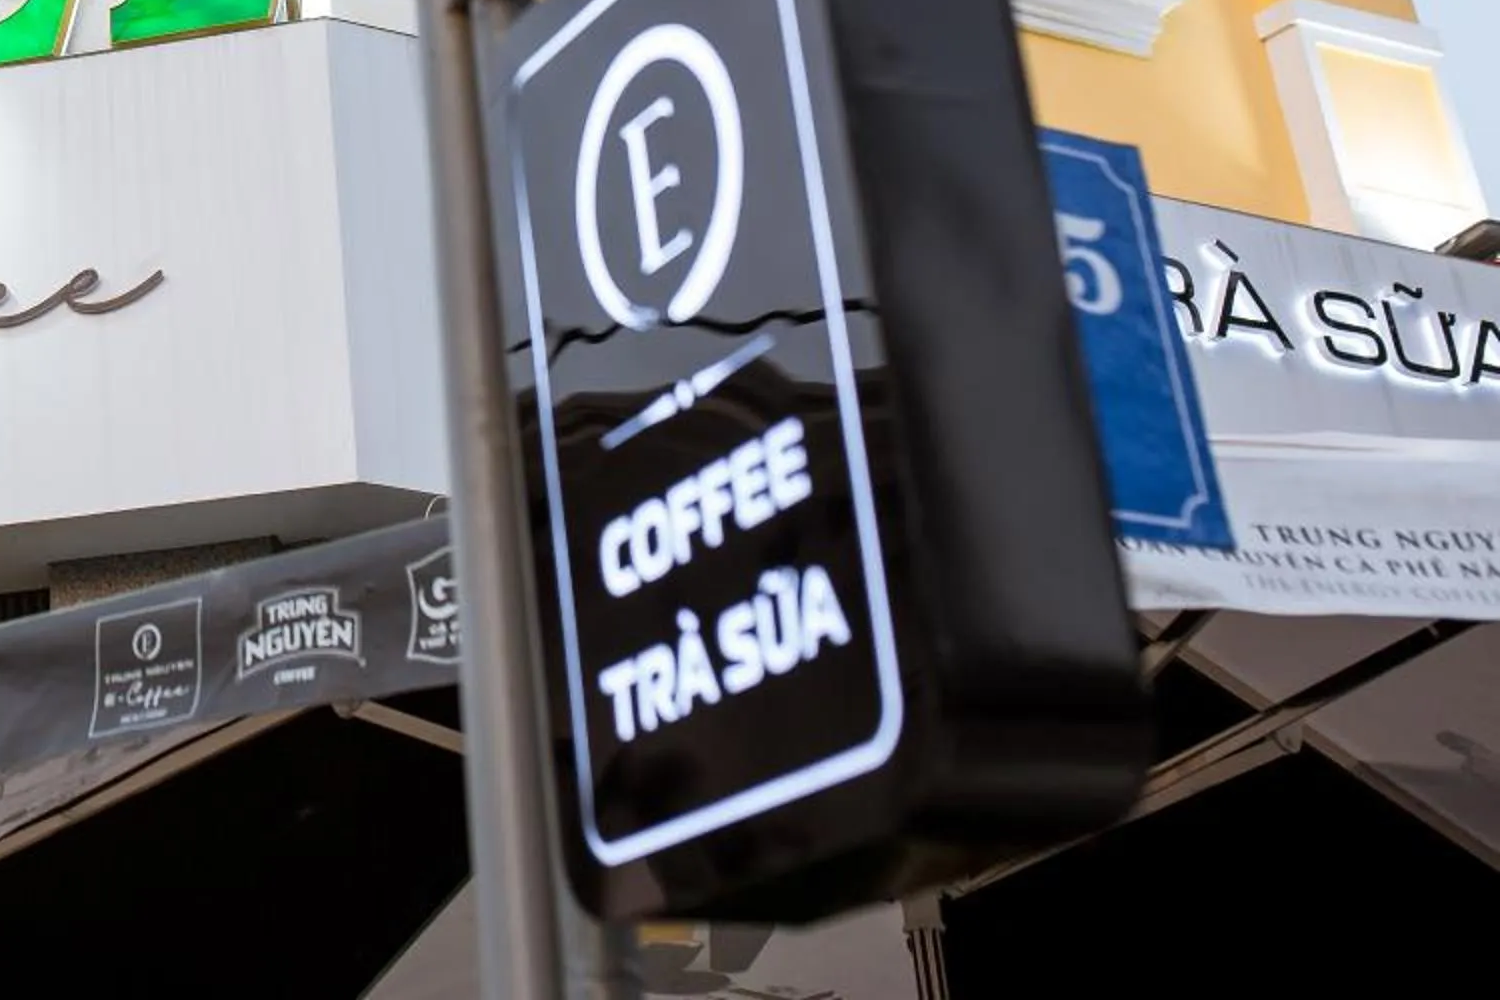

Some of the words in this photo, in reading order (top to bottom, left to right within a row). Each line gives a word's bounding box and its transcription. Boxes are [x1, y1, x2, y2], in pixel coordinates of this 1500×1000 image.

[1162, 238, 1296, 350] RÀ
[600, 416, 813, 597] COFFEE
[1252, 523, 1382, 549] TRUNG
[266, 594, 328, 625] TRUNG
[598, 607, 722, 742] TRÀ
